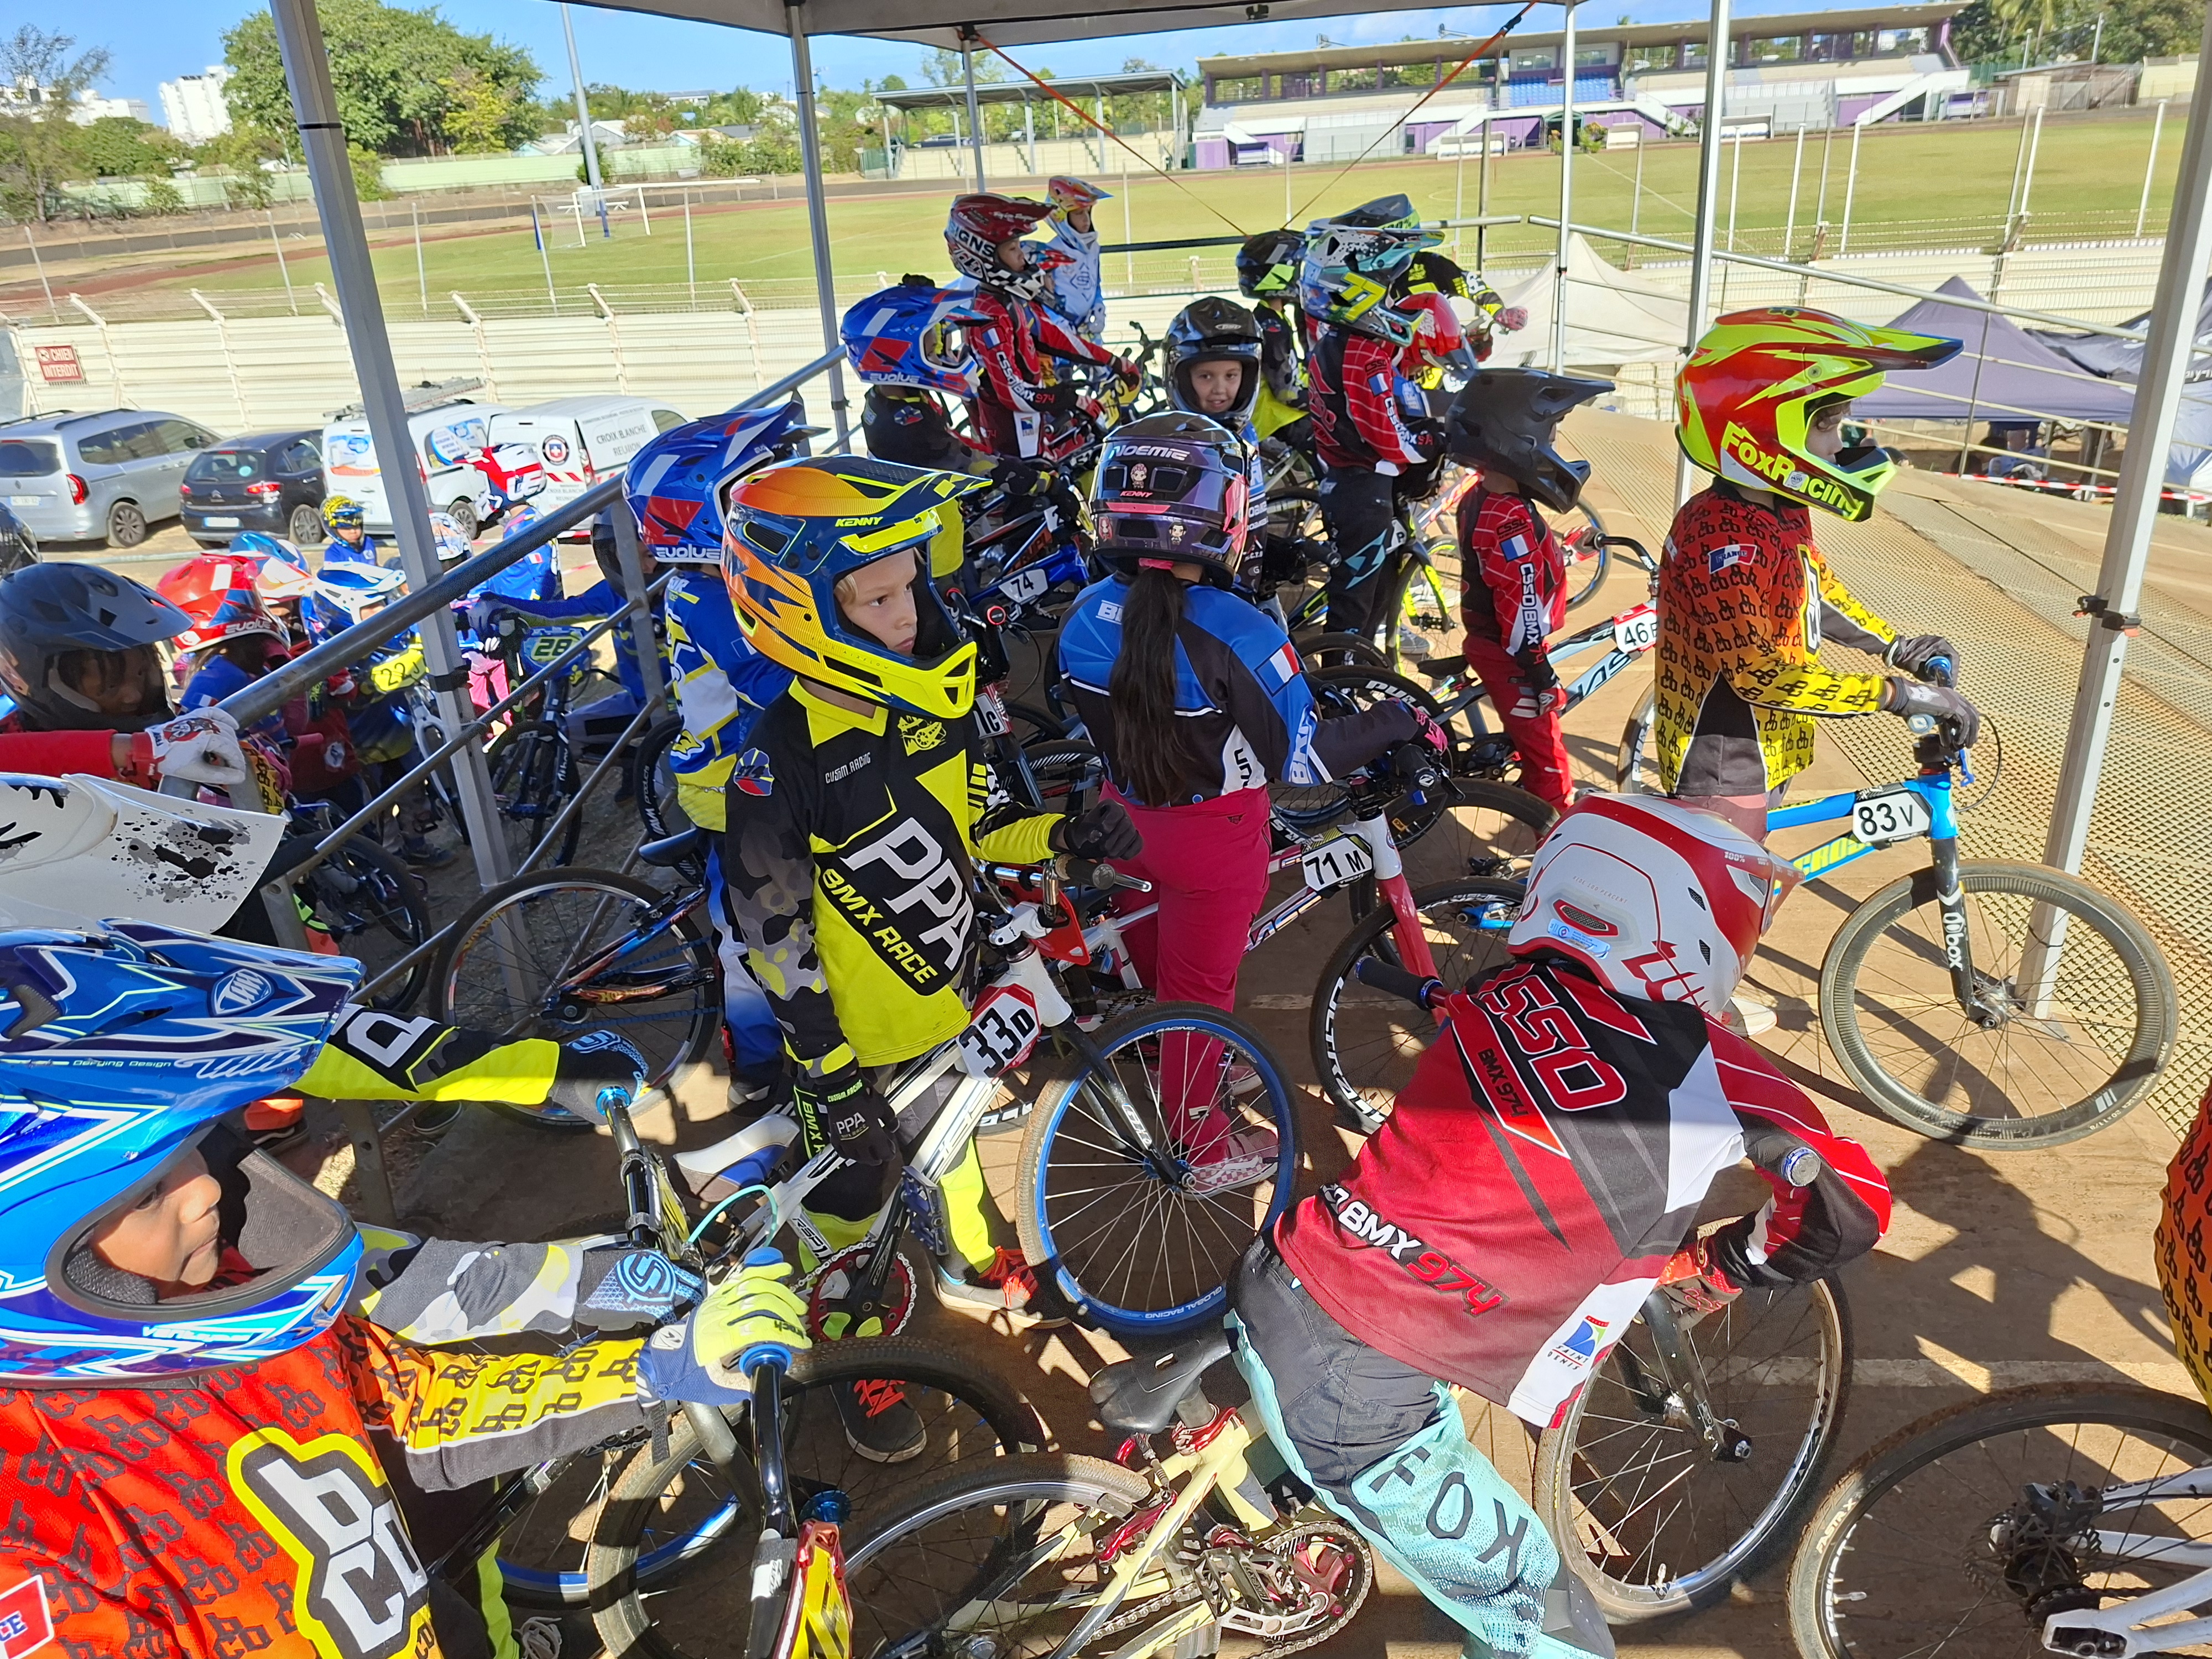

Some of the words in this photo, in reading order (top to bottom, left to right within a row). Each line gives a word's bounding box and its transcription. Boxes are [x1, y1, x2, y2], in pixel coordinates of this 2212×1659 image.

[50, 348, 74, 361] CHIEN
[41, 364, 79, 377] INTERDIT
[1035, 393, 1056, 404] 974
[597, 431, 619, 444] CROIX
[619, 424, 647, 439] BLANCHE
[613, 442, 641, 456] REUNION
[1109, 445, 1190, 461] NOEMIE
[836, 517, 883, 527] KENNY
[1011, 576, 1034, 599] 74
[534, 638, 573, 656] 28
[1724, 851, 1745, 863] 100%
[839, 817, 974, 972] PPA
[1573, 875, 1585, 885] RIDE
[1600, 889, 1627, 904] PERCENT
[822, 869, 884, 927] BMX
[873, 926, 938, 984] RACE
[72, 1059, 124, 1068] Defying
[129, 1058, 171, 1068] Design
[1477, 1048, 1505, 1084] BMX
[1495, 1077, 1528, 1118] 974
[802, 1100, 823, 1141] BMX
[836, 1112, 865, 1134] PPA
[1337, 1201, 1423, 1260] BMX
[1406, 1251, 1504, 1317] 974
[1185, 1285, 1222, 1310] GLOBAL
[1145, 1307, 1184, 1319] RACING
[1547, 1351, 1580, 1370] DENIS
[1556, 1345, 1589, 1363] SAINT
